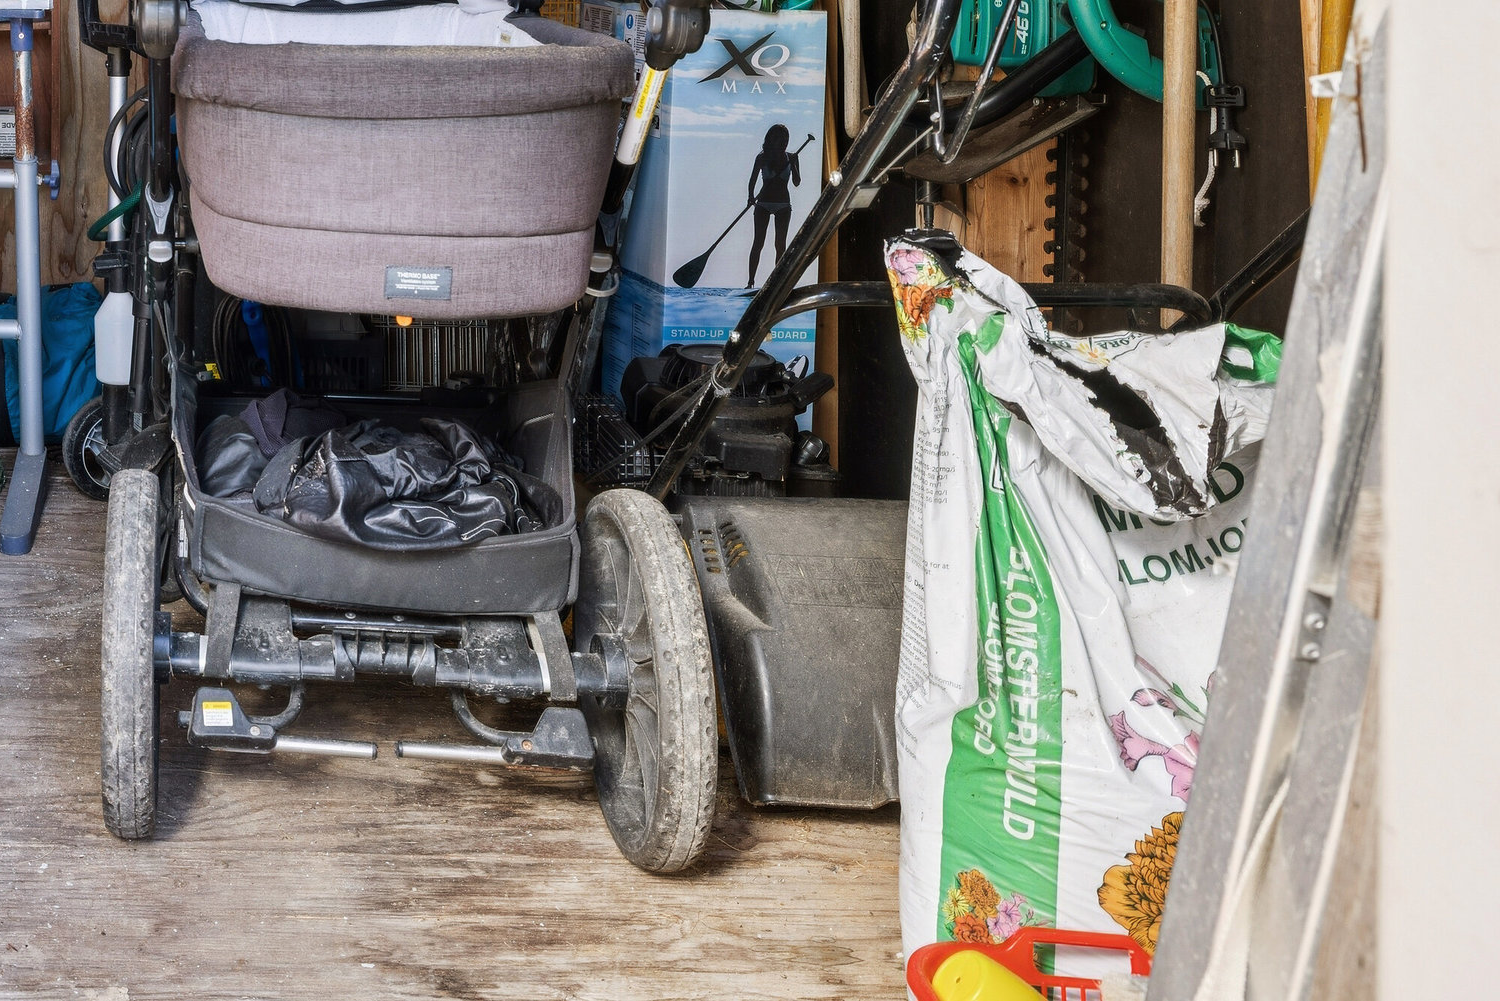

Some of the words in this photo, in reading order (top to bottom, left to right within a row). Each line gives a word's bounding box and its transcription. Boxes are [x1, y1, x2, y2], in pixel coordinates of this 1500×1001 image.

[696, 31, 790, 84] XQ
[721, 80, 787, 95] MAX
[670, 329, 724, 339] STAND-UP
[1093, 462, 1244, 533] MD
[1119, 517, 1248, 585] LOMJO
[1003, 546, 1038, 841] BLOMSTERMULD
